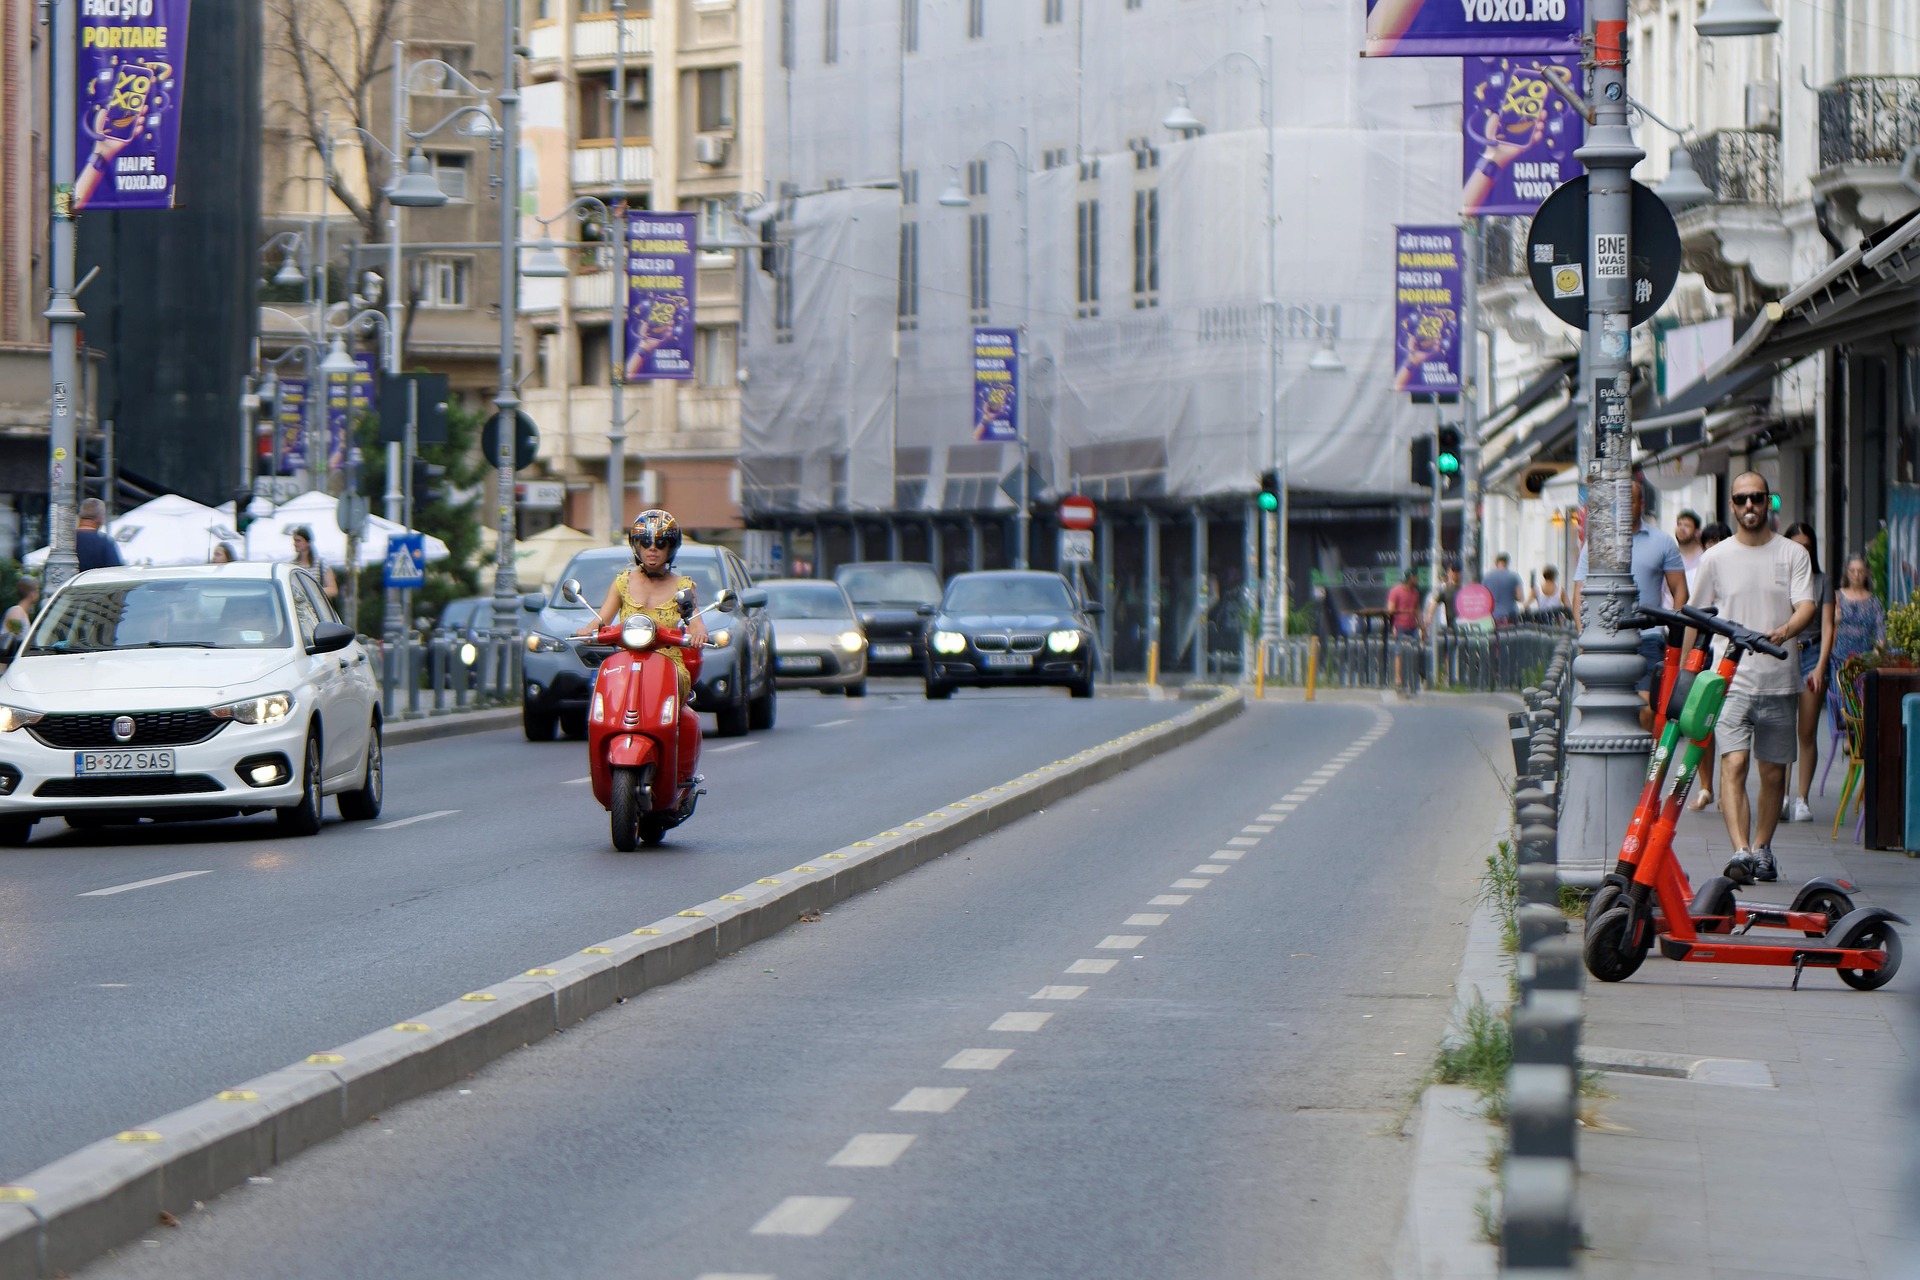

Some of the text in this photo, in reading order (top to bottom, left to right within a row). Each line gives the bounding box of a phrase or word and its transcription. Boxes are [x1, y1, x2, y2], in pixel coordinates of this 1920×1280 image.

[84, 0, 119, 16] FACI
[140, 0, 153, 16] O
[1461, 0, 1566, 22] YOXO.RO
[83, 26, 167, 48] PORTARE
[117, 156, 155, 172] HAI PE
[1514, 162, 1559, 179] HAI PE
[117, 174, 167, 190] YOXO.RO
[1513, 181, 1563, 199] YOXO
[676, 222, 684, 235] O
[1420, 235, 1443, 249] FACI
[1443, 235, 1452, 250] O
[1598, 237, 1626, 255] BNE
[632, 258, 655, 270] FACI
[1598, 255, 1626, 265] WAS
[1598, 265, 1626, 275] HERE
[631, 274, 685, 289] PORTARE
[1399, 271, 1422, 287] FACI
[1399, 288, 1452, 304] PORTARE
[118, 722, 131, 733] FIAT
[85, 753, 170, 771] B 322 SAS
